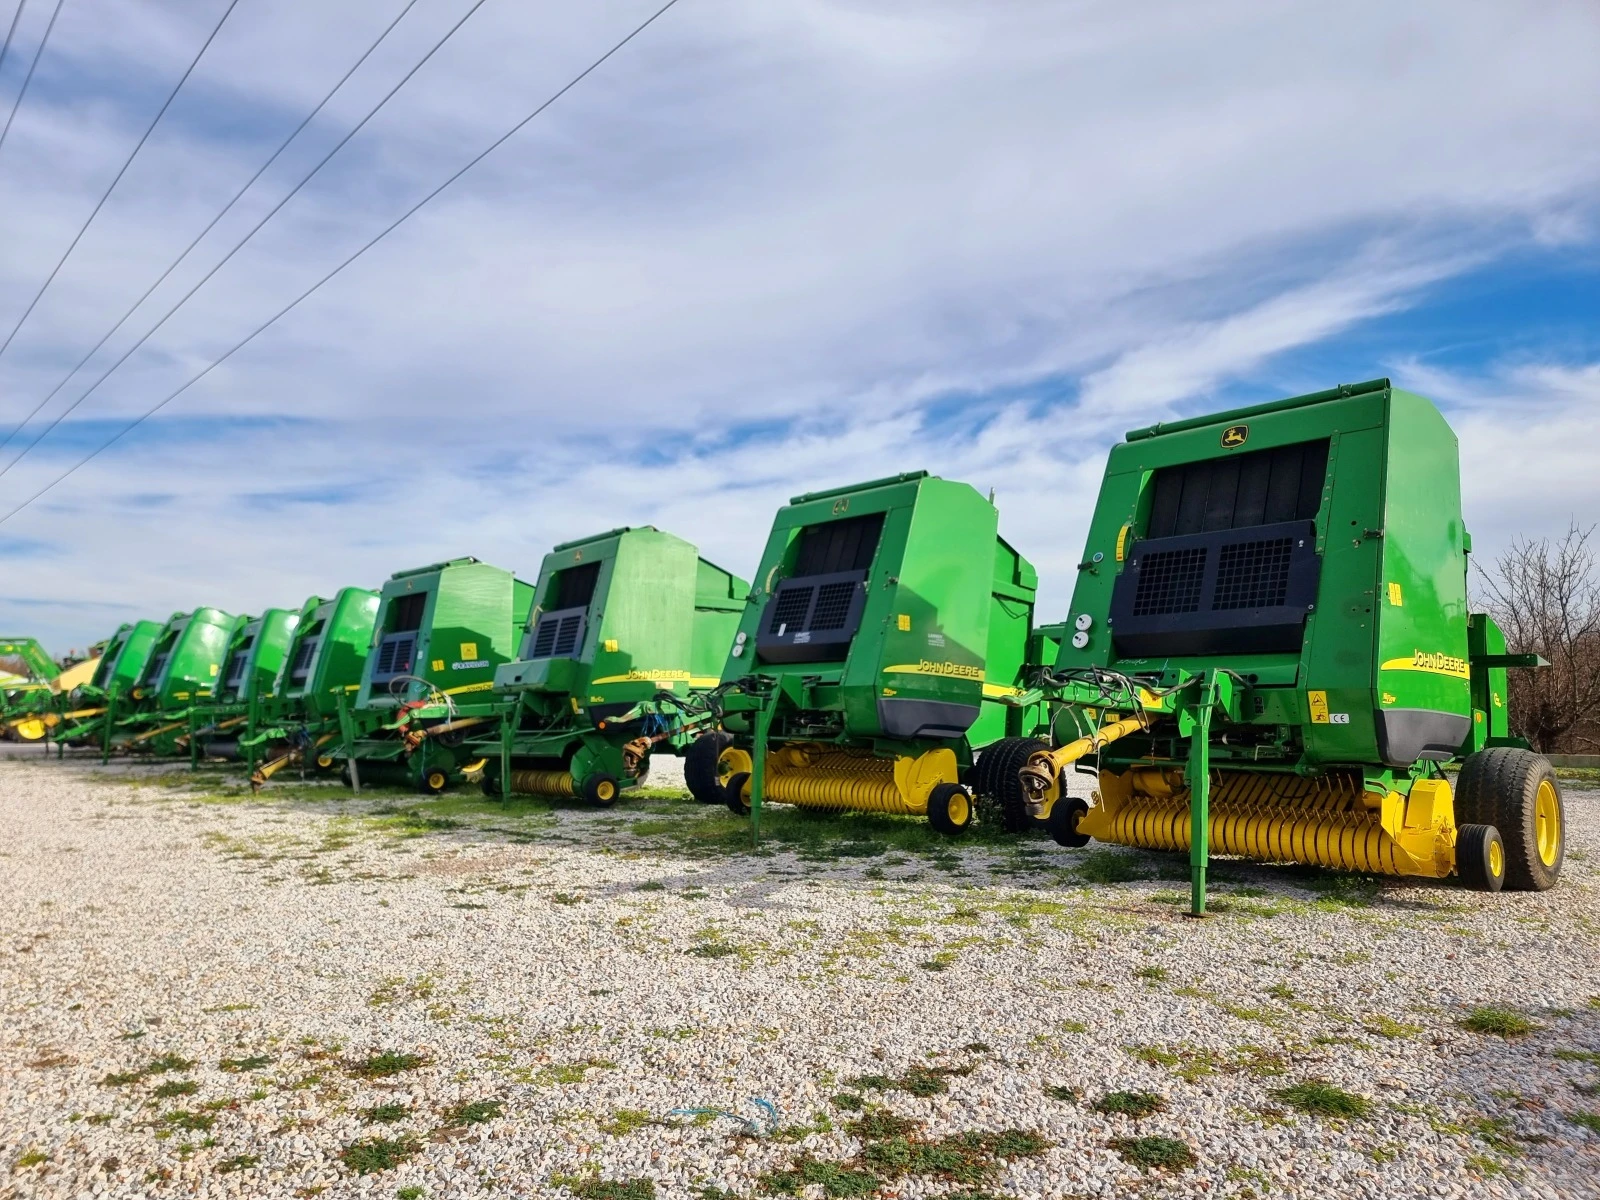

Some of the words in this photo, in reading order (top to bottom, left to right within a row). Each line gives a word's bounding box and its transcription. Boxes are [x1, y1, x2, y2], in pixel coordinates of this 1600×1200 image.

[917, 659, 944, 674] JOHN
[944, 662, 979, 678] DEERE
[1413, 649, 1437, 669] JOHN
[1437, 652, 1465, 673] DEERE
[625, 670, 652, 680] JOHN
[652, 669, 684, 679] DEERE
